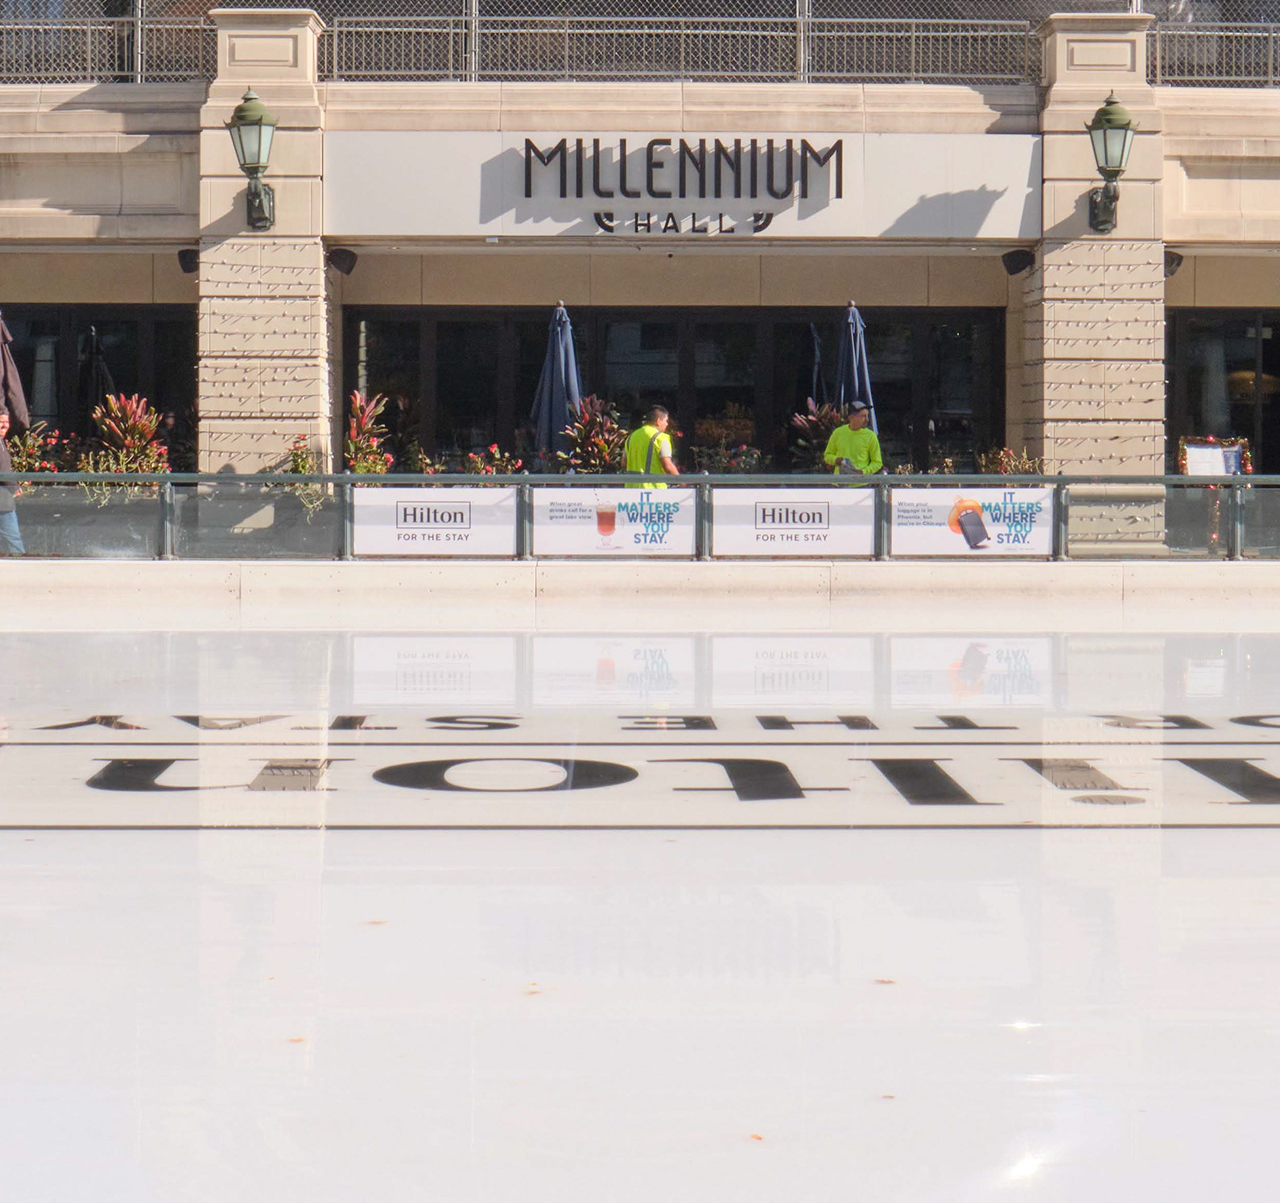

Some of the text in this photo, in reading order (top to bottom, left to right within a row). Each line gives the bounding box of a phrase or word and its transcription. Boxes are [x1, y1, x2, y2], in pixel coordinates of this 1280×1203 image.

[524, 137, 843, 200] MILLENNIUM
[634, 212, 735, 233] HALL
[639, 491, 652, 502] IT
[1003, 491, 1015, 502] IT
[617, 502, 679, 513] MATTERS
[981, 502, 1043, 513] MATTERS
[402, 506, 464, 523] Hilton
[627, 512, 674, 523] WHERE
[761, 507, 823, 524] Hilton
[990, 512, 1037, 523] WHERE
[643, 522, 670, 533] YOU
[1006, 522, 1032, 533] YOU
[397, 533, 470, 541] FOR THE STAY
[633, 533, 667, 544] STAY.
[996, 533, 1030, 544] STAY.
[30, 714, 525, 731] STAY
[617, 714, 1020, 731] THE
